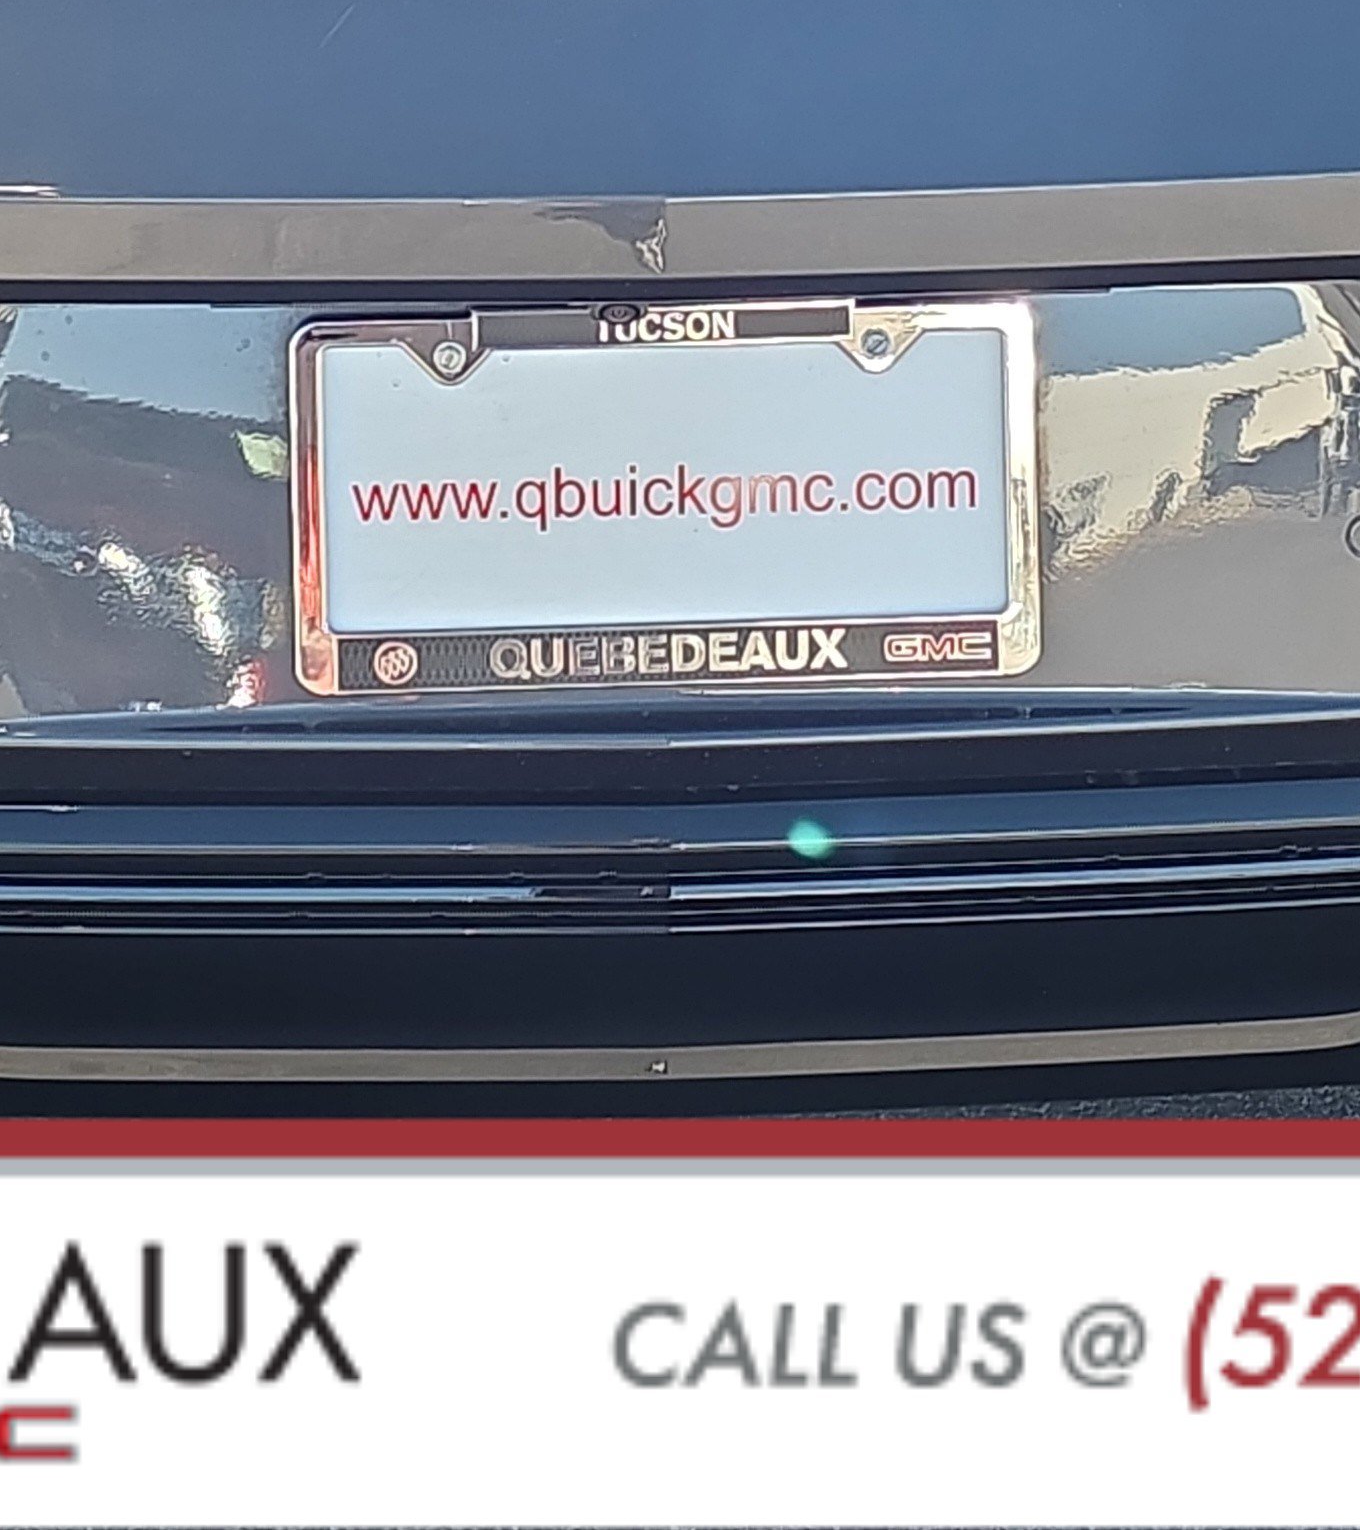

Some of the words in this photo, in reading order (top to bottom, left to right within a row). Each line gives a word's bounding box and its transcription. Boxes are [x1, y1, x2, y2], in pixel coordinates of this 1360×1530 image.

[351, 463, 978, 532] www.qbuickgmc.com
[488, 627, 849, 680] QUEBEDEAUX
[882, 631, 994, 663] GMC
